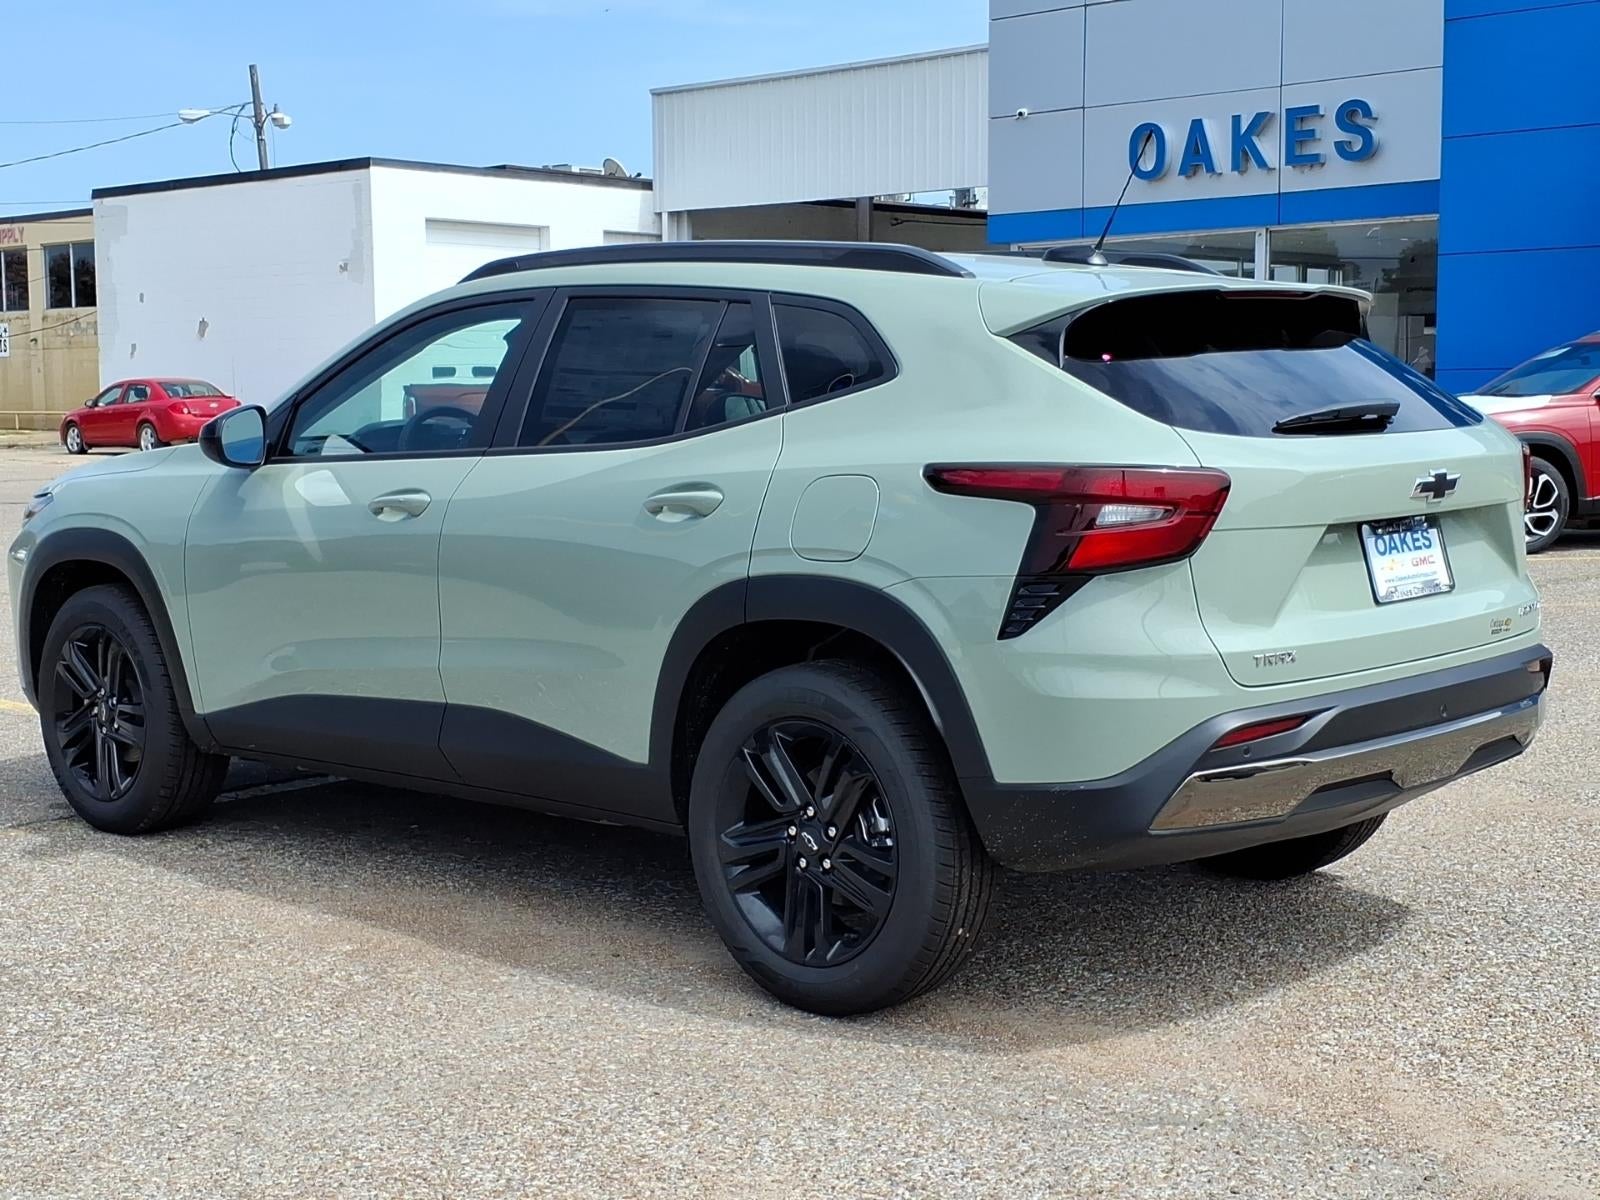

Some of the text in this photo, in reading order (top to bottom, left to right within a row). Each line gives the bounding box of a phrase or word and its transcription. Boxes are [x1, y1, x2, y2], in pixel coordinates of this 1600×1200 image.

[1128, 98, 1379, 181] OAKES
[0, 226, 25, 244] PPLY
[1374, 529, 1432, 556] OAKES
[1411, 554, 1436, 567] GMC
